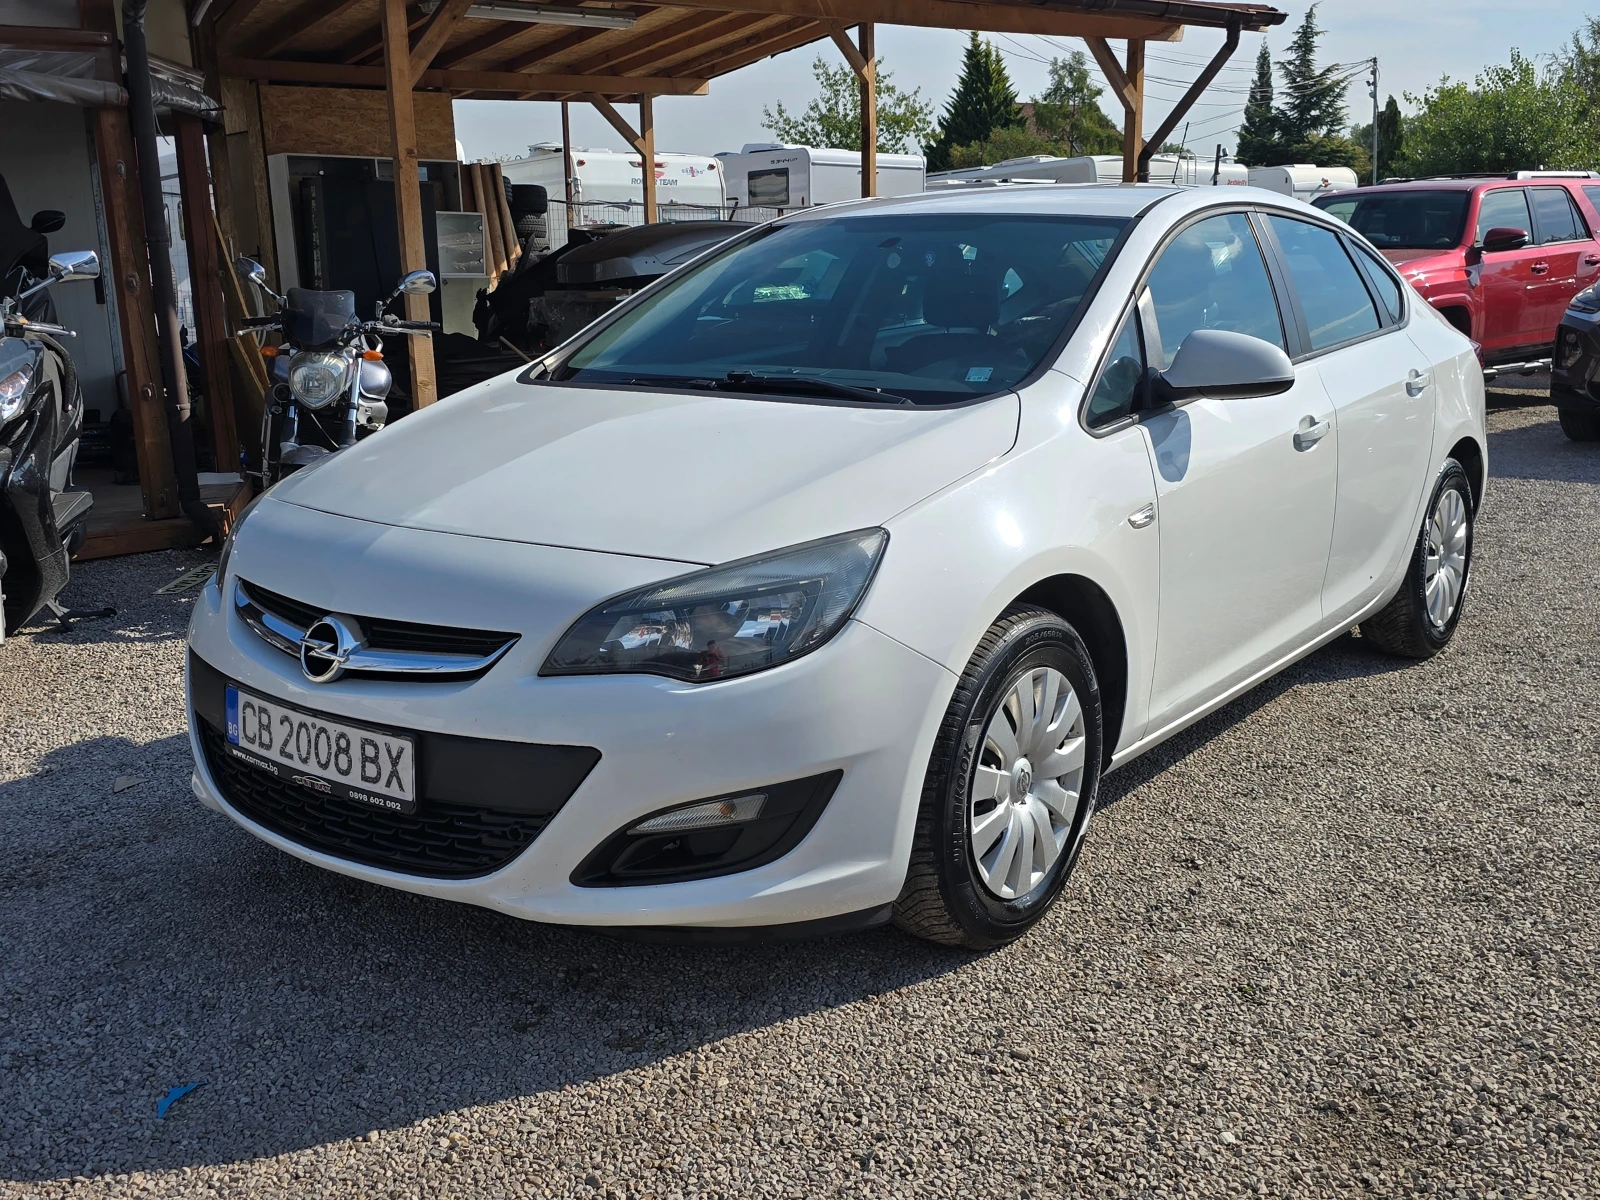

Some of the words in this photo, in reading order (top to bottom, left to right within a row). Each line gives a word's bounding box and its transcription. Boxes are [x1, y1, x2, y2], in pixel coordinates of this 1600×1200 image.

[659, 178, 678, 186] TEAM
[228, 721, 238, 736] BG
[242, 700, 273, 751] CB
[279, 714, 353, 776] 2008
[360, 737, 406, 793] BX
[232, 748, 279, 775] www.carmax.bg
[348, 790, 368, 801] 0898
[369, 796, 385, 806] 602
[386, 800, 402, 810] 002
